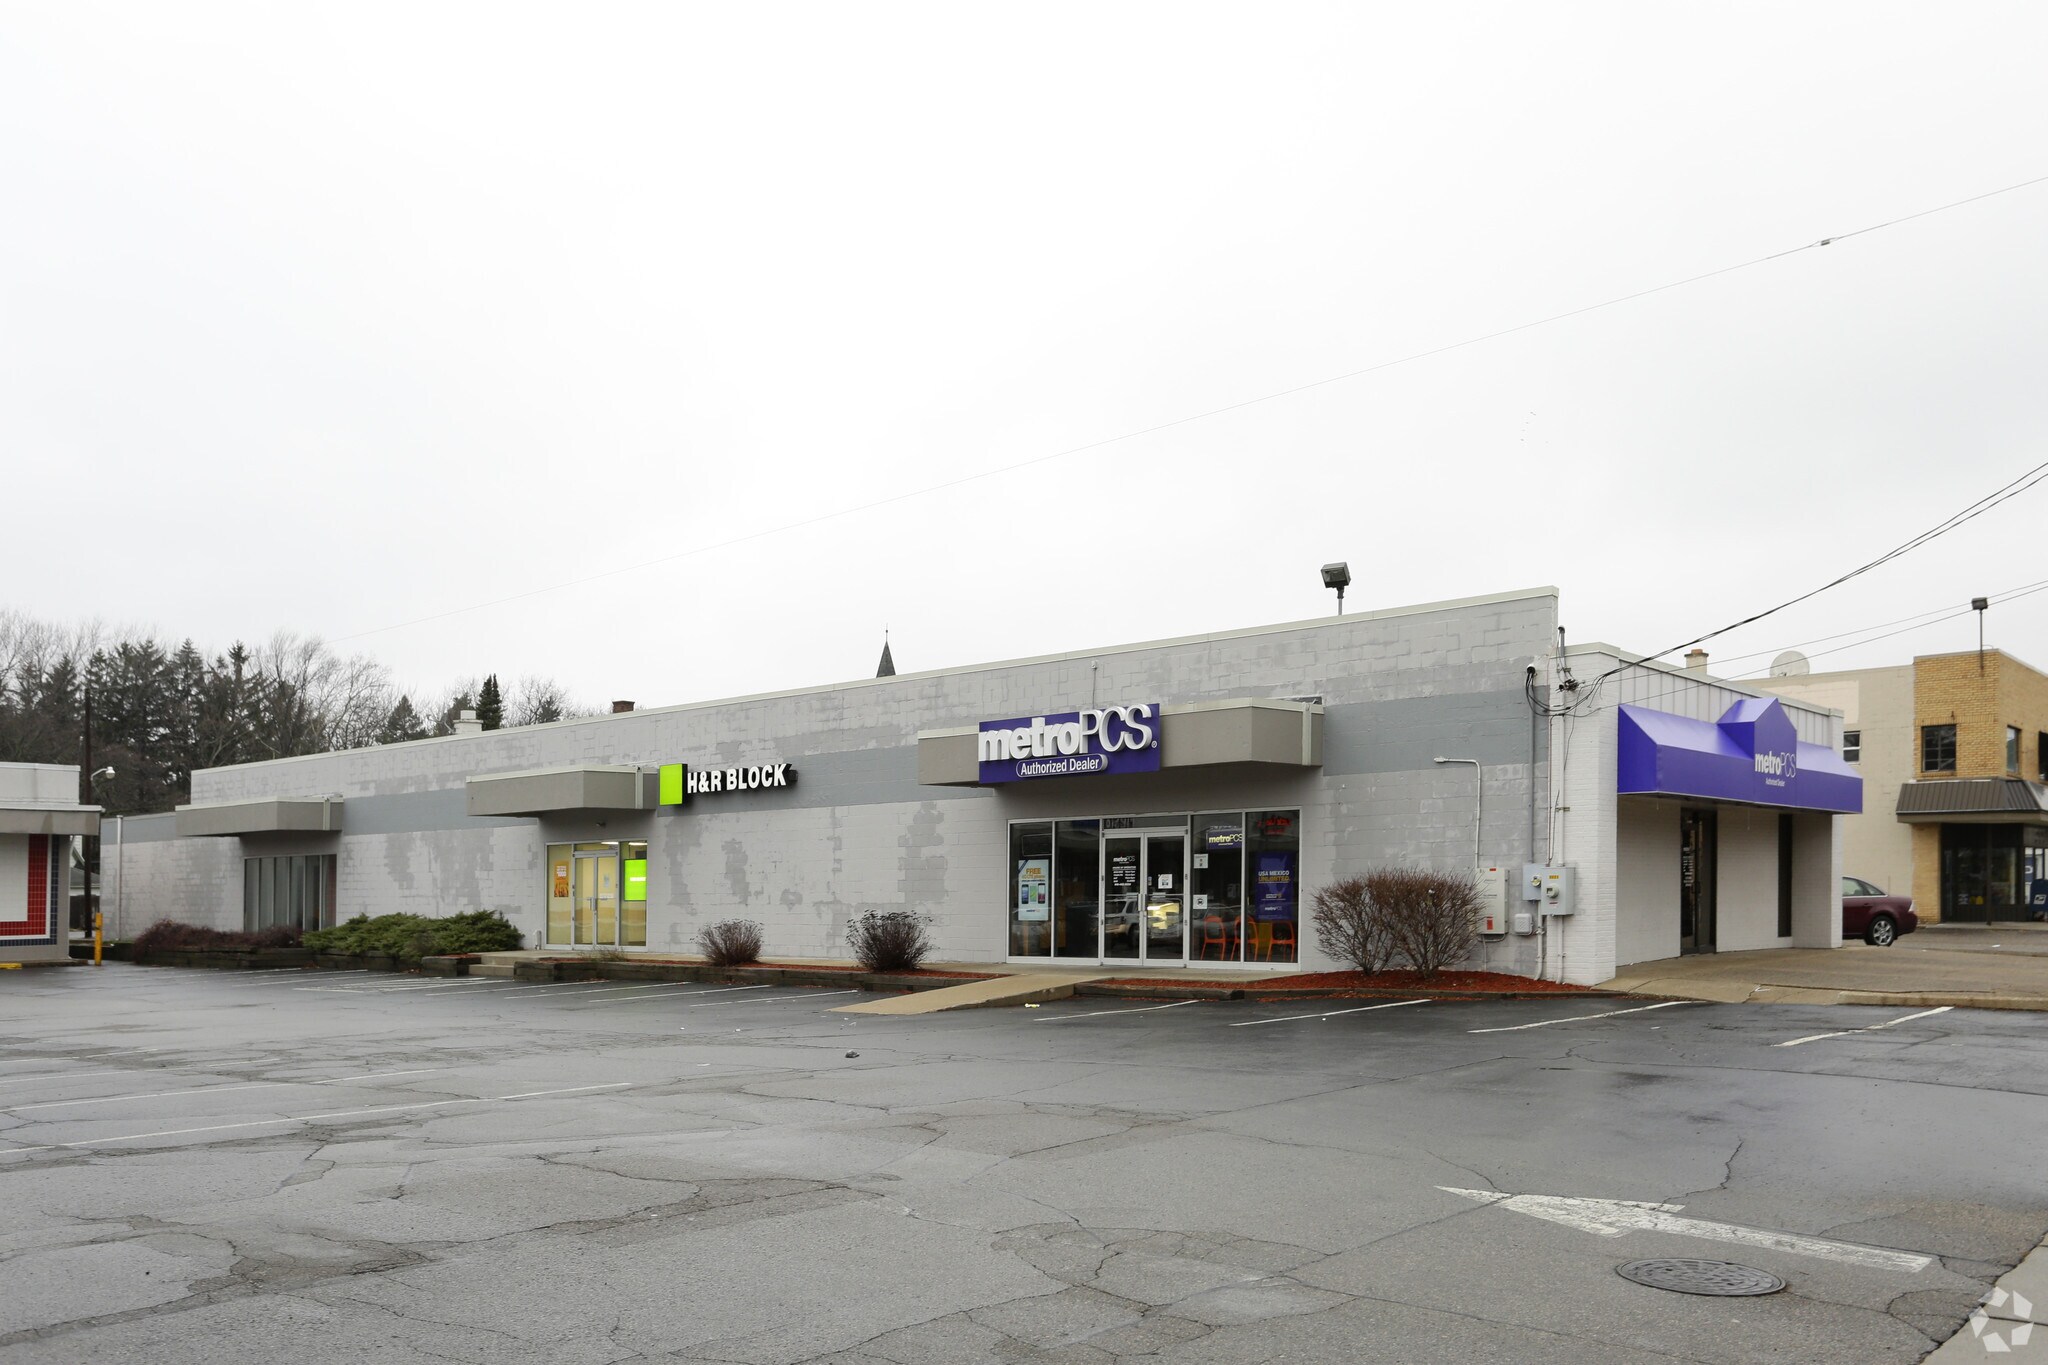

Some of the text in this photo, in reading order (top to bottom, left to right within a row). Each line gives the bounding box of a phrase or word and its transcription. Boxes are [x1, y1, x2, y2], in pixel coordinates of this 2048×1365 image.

[979, 704, 1152, 761] metroPCS
[1021, 757, 1100, 775] Authorized Dealer
[1755, 751, 1796, 777] metroPCS
[687, 763, 788, 794] H&R BLOCK
